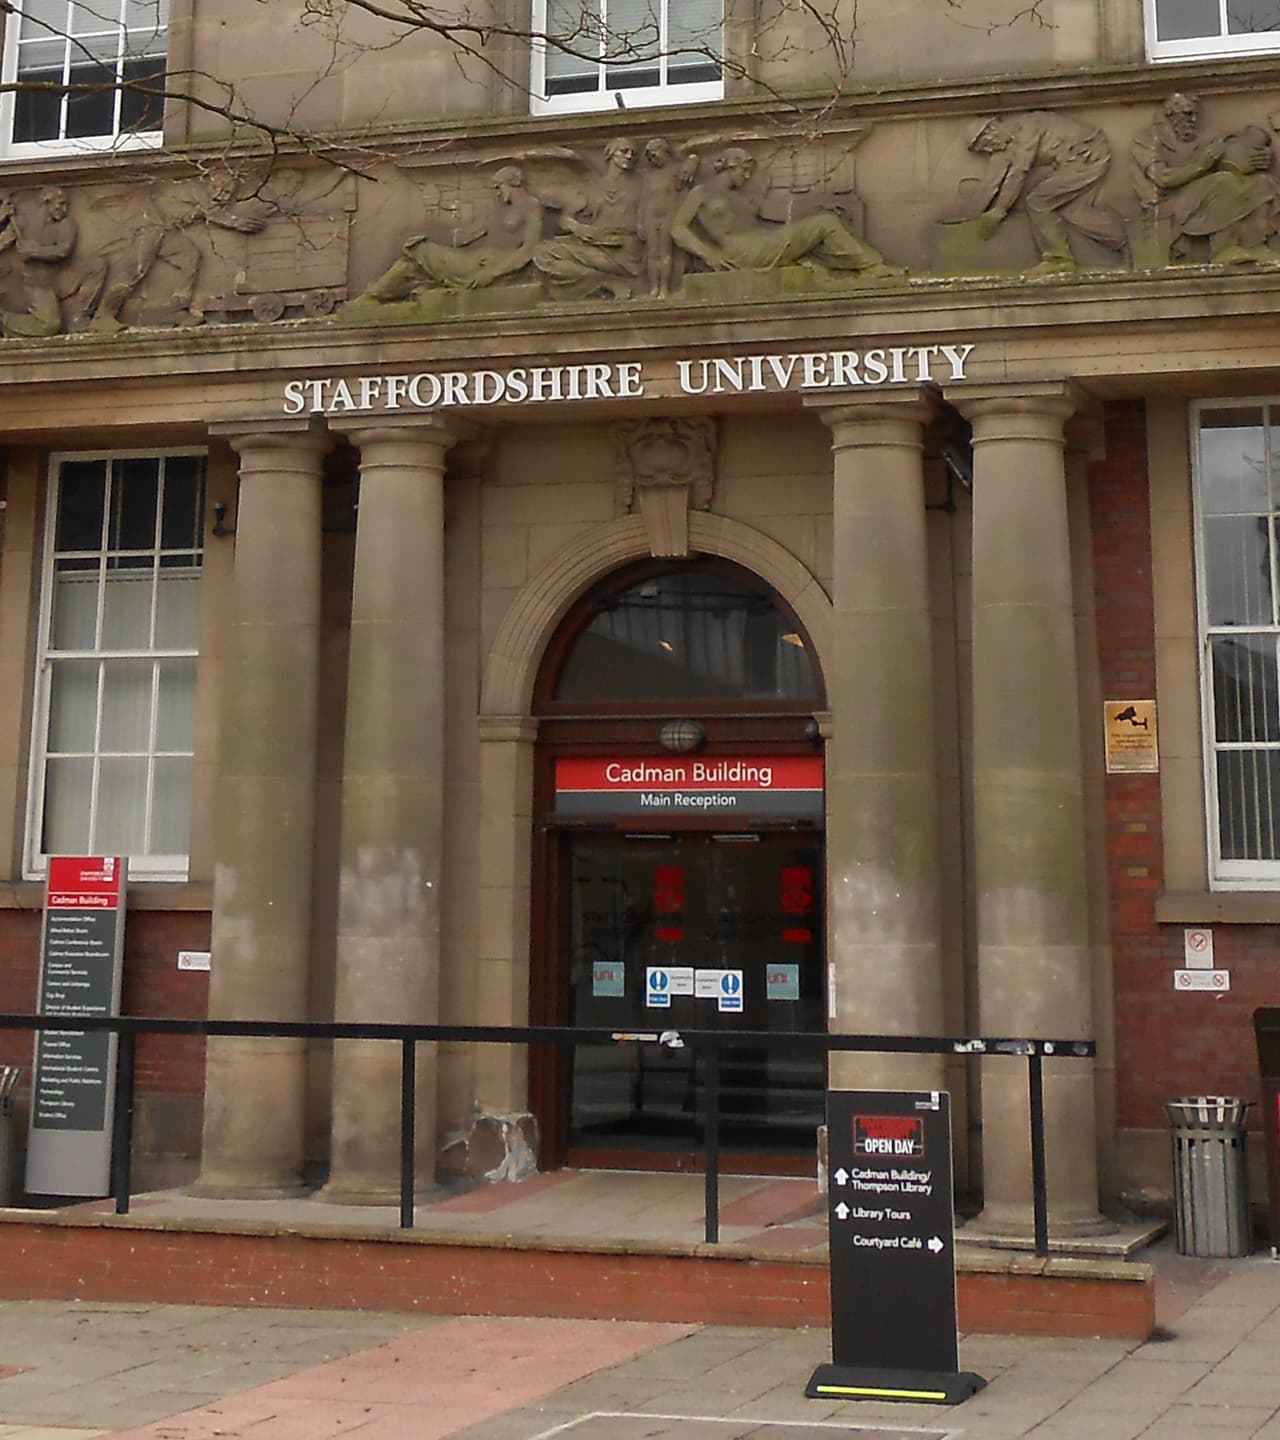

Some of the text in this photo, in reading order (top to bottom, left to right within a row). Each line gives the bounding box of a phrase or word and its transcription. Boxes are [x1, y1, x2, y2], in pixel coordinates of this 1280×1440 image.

[283, 344, 976, 414] STAFFORDSHIRE UNIVERSITY
[606, 762, 772, 786] Cadman Building
[641, 794, 736, 809] Main Reception
[52, 896, 108, 906] Cadman Building
[865, 1139, 914, 1154] OPEN DAY
[852, 1168, 889, 1180] Cadman
[852, 1180, 932, 1196] Thompson Library
[853, 1208, 911, 1221] Library Tours
[853, 1235, 922, 1250] Courtyard Café
